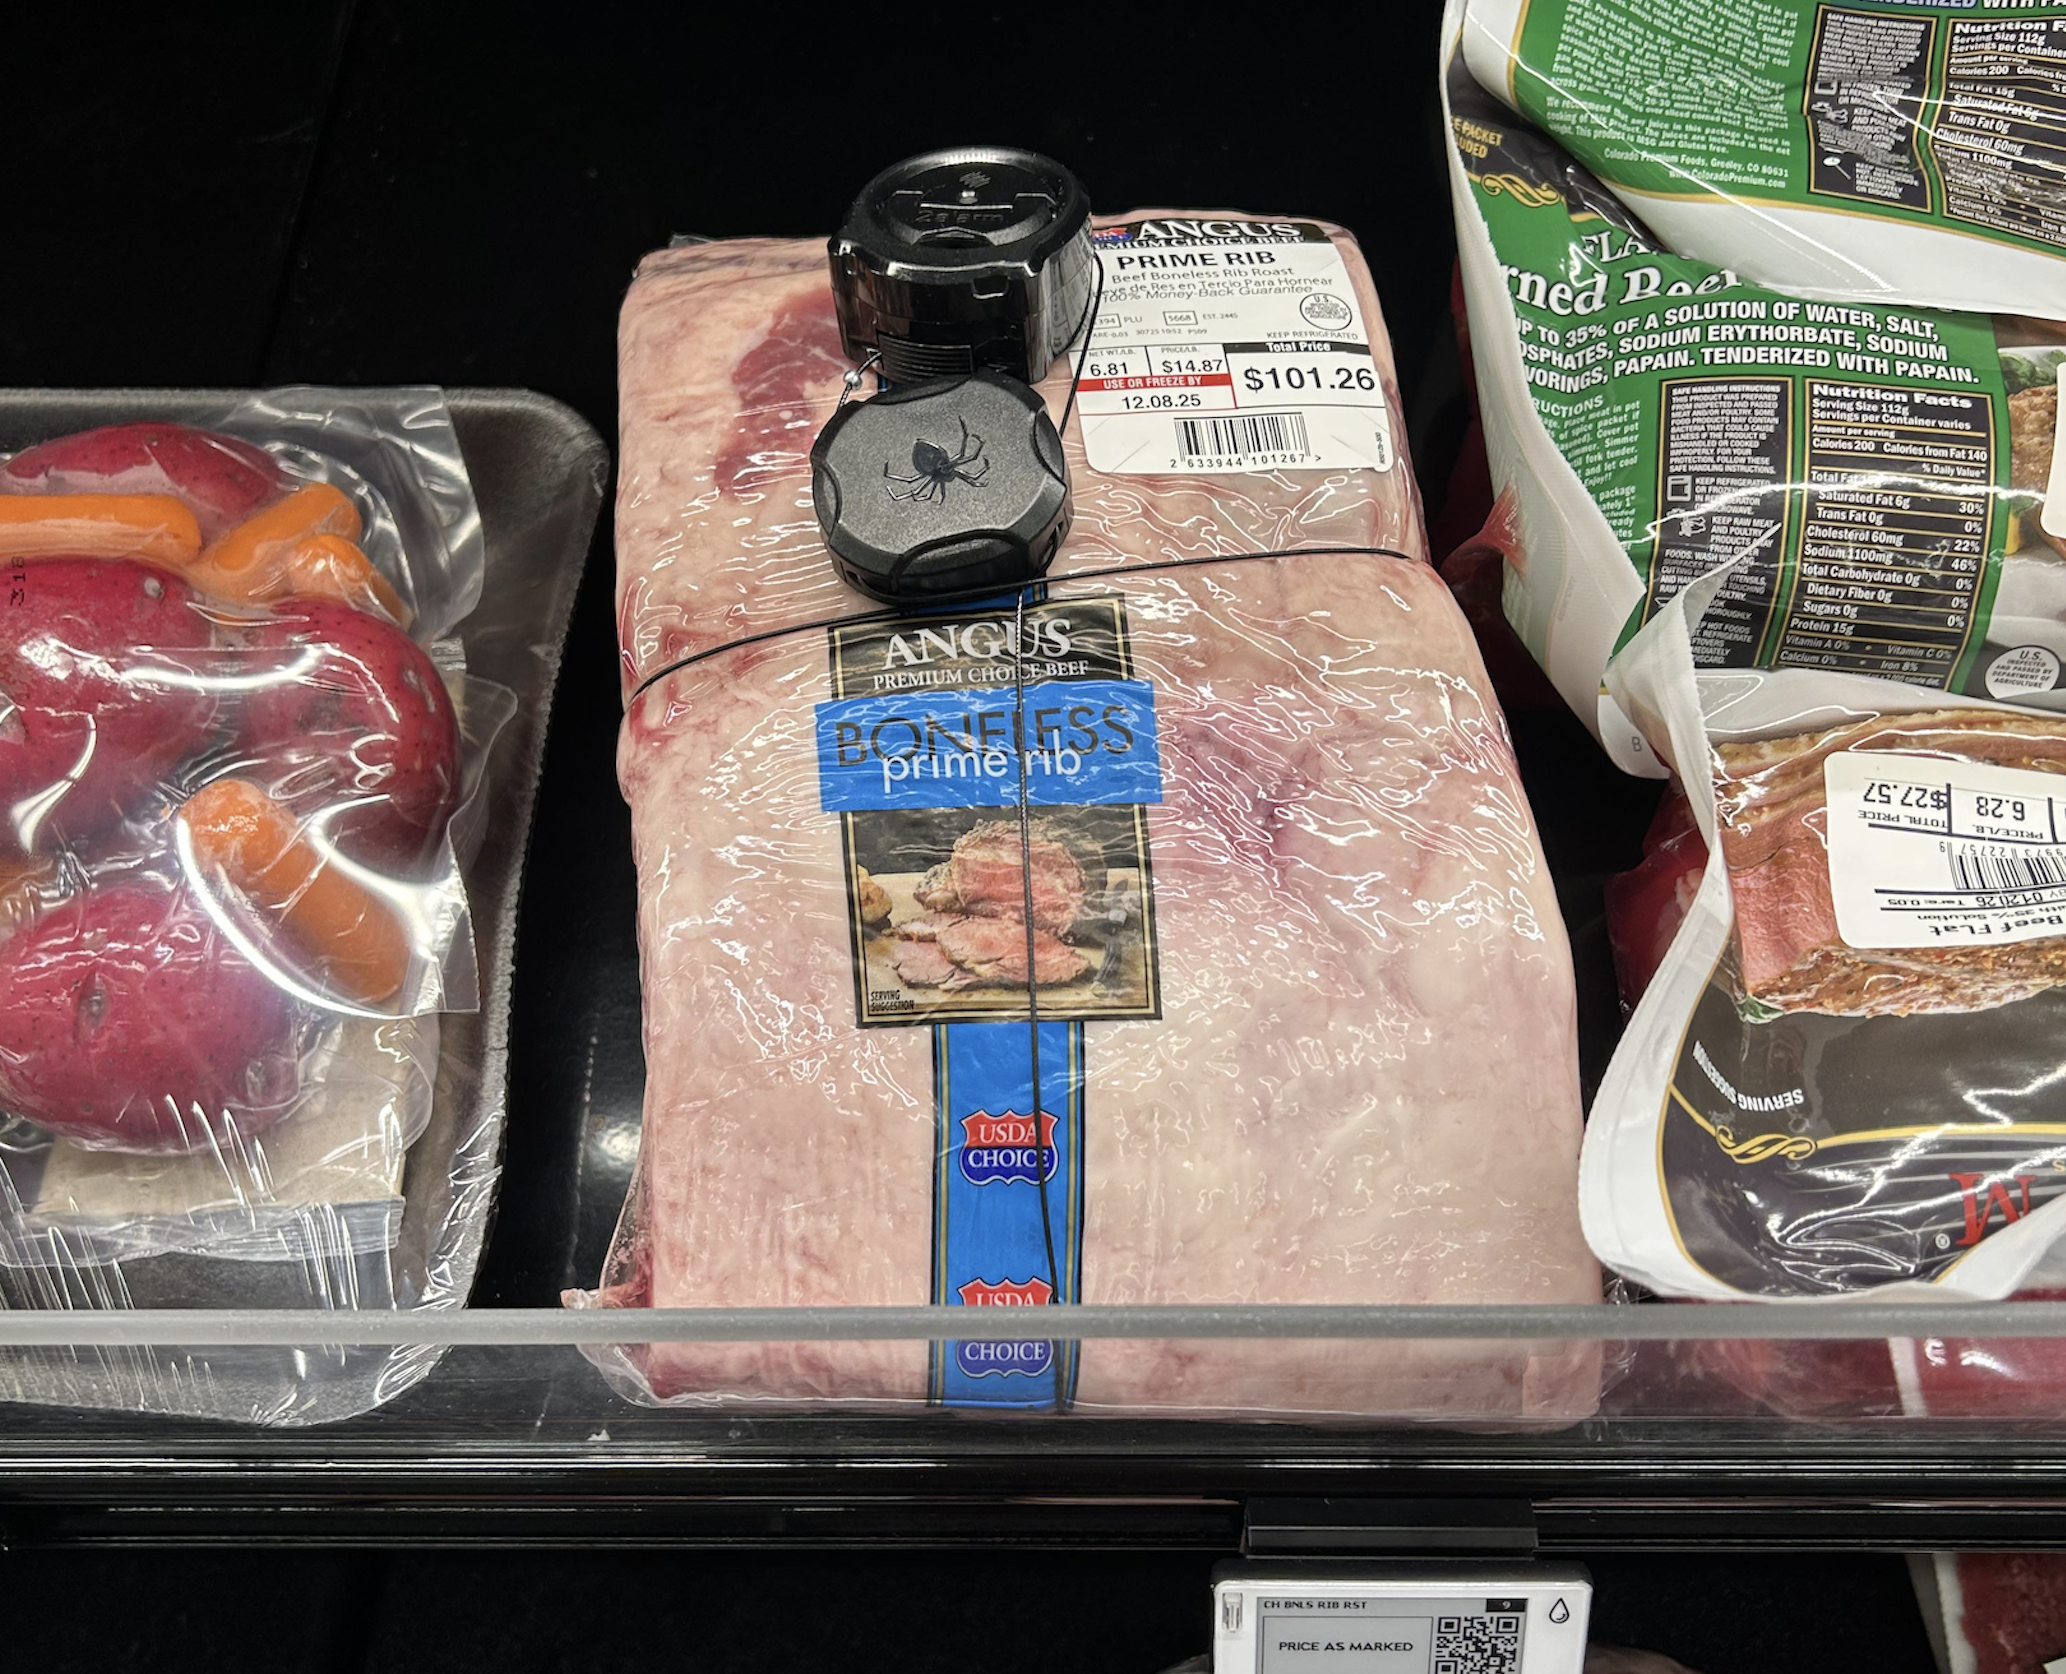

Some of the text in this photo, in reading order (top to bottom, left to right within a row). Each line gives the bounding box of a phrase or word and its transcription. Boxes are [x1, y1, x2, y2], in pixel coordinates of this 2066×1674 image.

[1603, 146, 1639, 162] Colorado
[1747, 162, 1760, 173] CO
[1136, 219, 1303, 241] ANGUS
[1580, 230, 1658, 263] FLA
[1117, 250, 1277, 270] PRIME RIB
[1111, 267, 1295, 284] Beef Boneless Rib Roast
[1129, 284, 1148, 293] de
[1151, 282, 1175, 291] Res
[1178, 283, 1196, 291] en
[1244, 278, 1275, 288] Para
[1277, 277, 1333, 286] Hornear
[1146, 288, 1235, 300] Money-Back
[1239, 285, 1313, 296] Guarantee
[1500, 264, 1609, 316] rned
[1266, 330, 1359, 340] KEEP REFRIGERATED
[1536, 300, 1940, 349] TO 35% OF A SOLUTION OF WATER, SALT,
[1266, 341, 1332, 354] Total Price
[1519, 323, 1949, 372] OSPHATES, SODIUM ERYTHORBATE, SODIUM
[1090, 359, 1376, 394] 6.81 $14.87 $101.26
[1524, 346, 1980, 394] VORINGS, PAPAIN. TENDERIZED WITH PAPAIN.
[1102, 375, 1202, 390] USE OR FREEZE BY
[1120, 393, 1202, 411] 12.08.25
[1812, 383, 1973, 409] Nutrition Facts
[1812, 398, 1910, 417] Serving Size 112g
[1812, 408, 1972, 431] Servings per Container varies
[1812, 437, 1988, 462] Calories 200 Calories from Fat 140
[1187, 456, 1244, 469] 633944
[1251, 453, 1306, 466] 101267
[1921, 462, 1932, 473] %
[1932, 464, 1955, 477] Daily
[1811, 470, 1839, 483] Total
[1818, 489, 1985, 515] Saturated Fat 6g 30%
[1816, 506, 1983, 534] Trans Fat 0g 0%
[1807, 524, 1981, 553] Cholesterol 60mg 22%
[1803, 543, 1977, 572] Sodium 1100mg 46%
[1801, 562, 1973, 591] Total Carbohydrate 0g 0%
[1806, 582, 1969, 610] Dietary Fiber 0g 0%
[1802, 600, 1965, 628] Sugars 0g 0%
[1790, 618, 1856, 636] Protein 15g
[881, 617, 1072, 671] ANGUS
[2006, 659, 2047, 668] INSPECTED
[2019, 650, 2043, 661] U.S.
[872, 659, 1090, 691] PREMIUM CHOICE BEEF
[1991, 670, 2039, 681] DEPARTMENT
[2012, 665, 2041, 674] PASSED
[1993, 677, 2044, 689] AGRICULTURE
[835, 704, 1135, 768] BONELESS
[883, 729, 1082, 794] prime rib
[1862, 782, 1949, 811] $27.57
[1857, 809, 1947, 829] TOTAL PRICE
[1975, 795, 2026, 822] 6.28
[1972, 823, 2044, 840] PRICE/LB.
[1888, 892, 2044, 908] 01.20.26 Tare: 0.05
[2000, 914, 2064, 933] Beef
[869, 989, 901, 1002] SERVING
[869, 1000, 915, 1012] SUGGESTION
[1692, 1039, 1805, 1112] SERVING SUGGESTION
[978, 1122, 1039, 1144] USDA
[967, 1148, 1051, 1169] CHOICE
[964, 1341, 1046, 1362] CHOICE
[1263, 1600, 1511, 1611] CH BNLS RIB RST 9
[1278, 1641, 1414, 1653] PRICE AS MARKED
